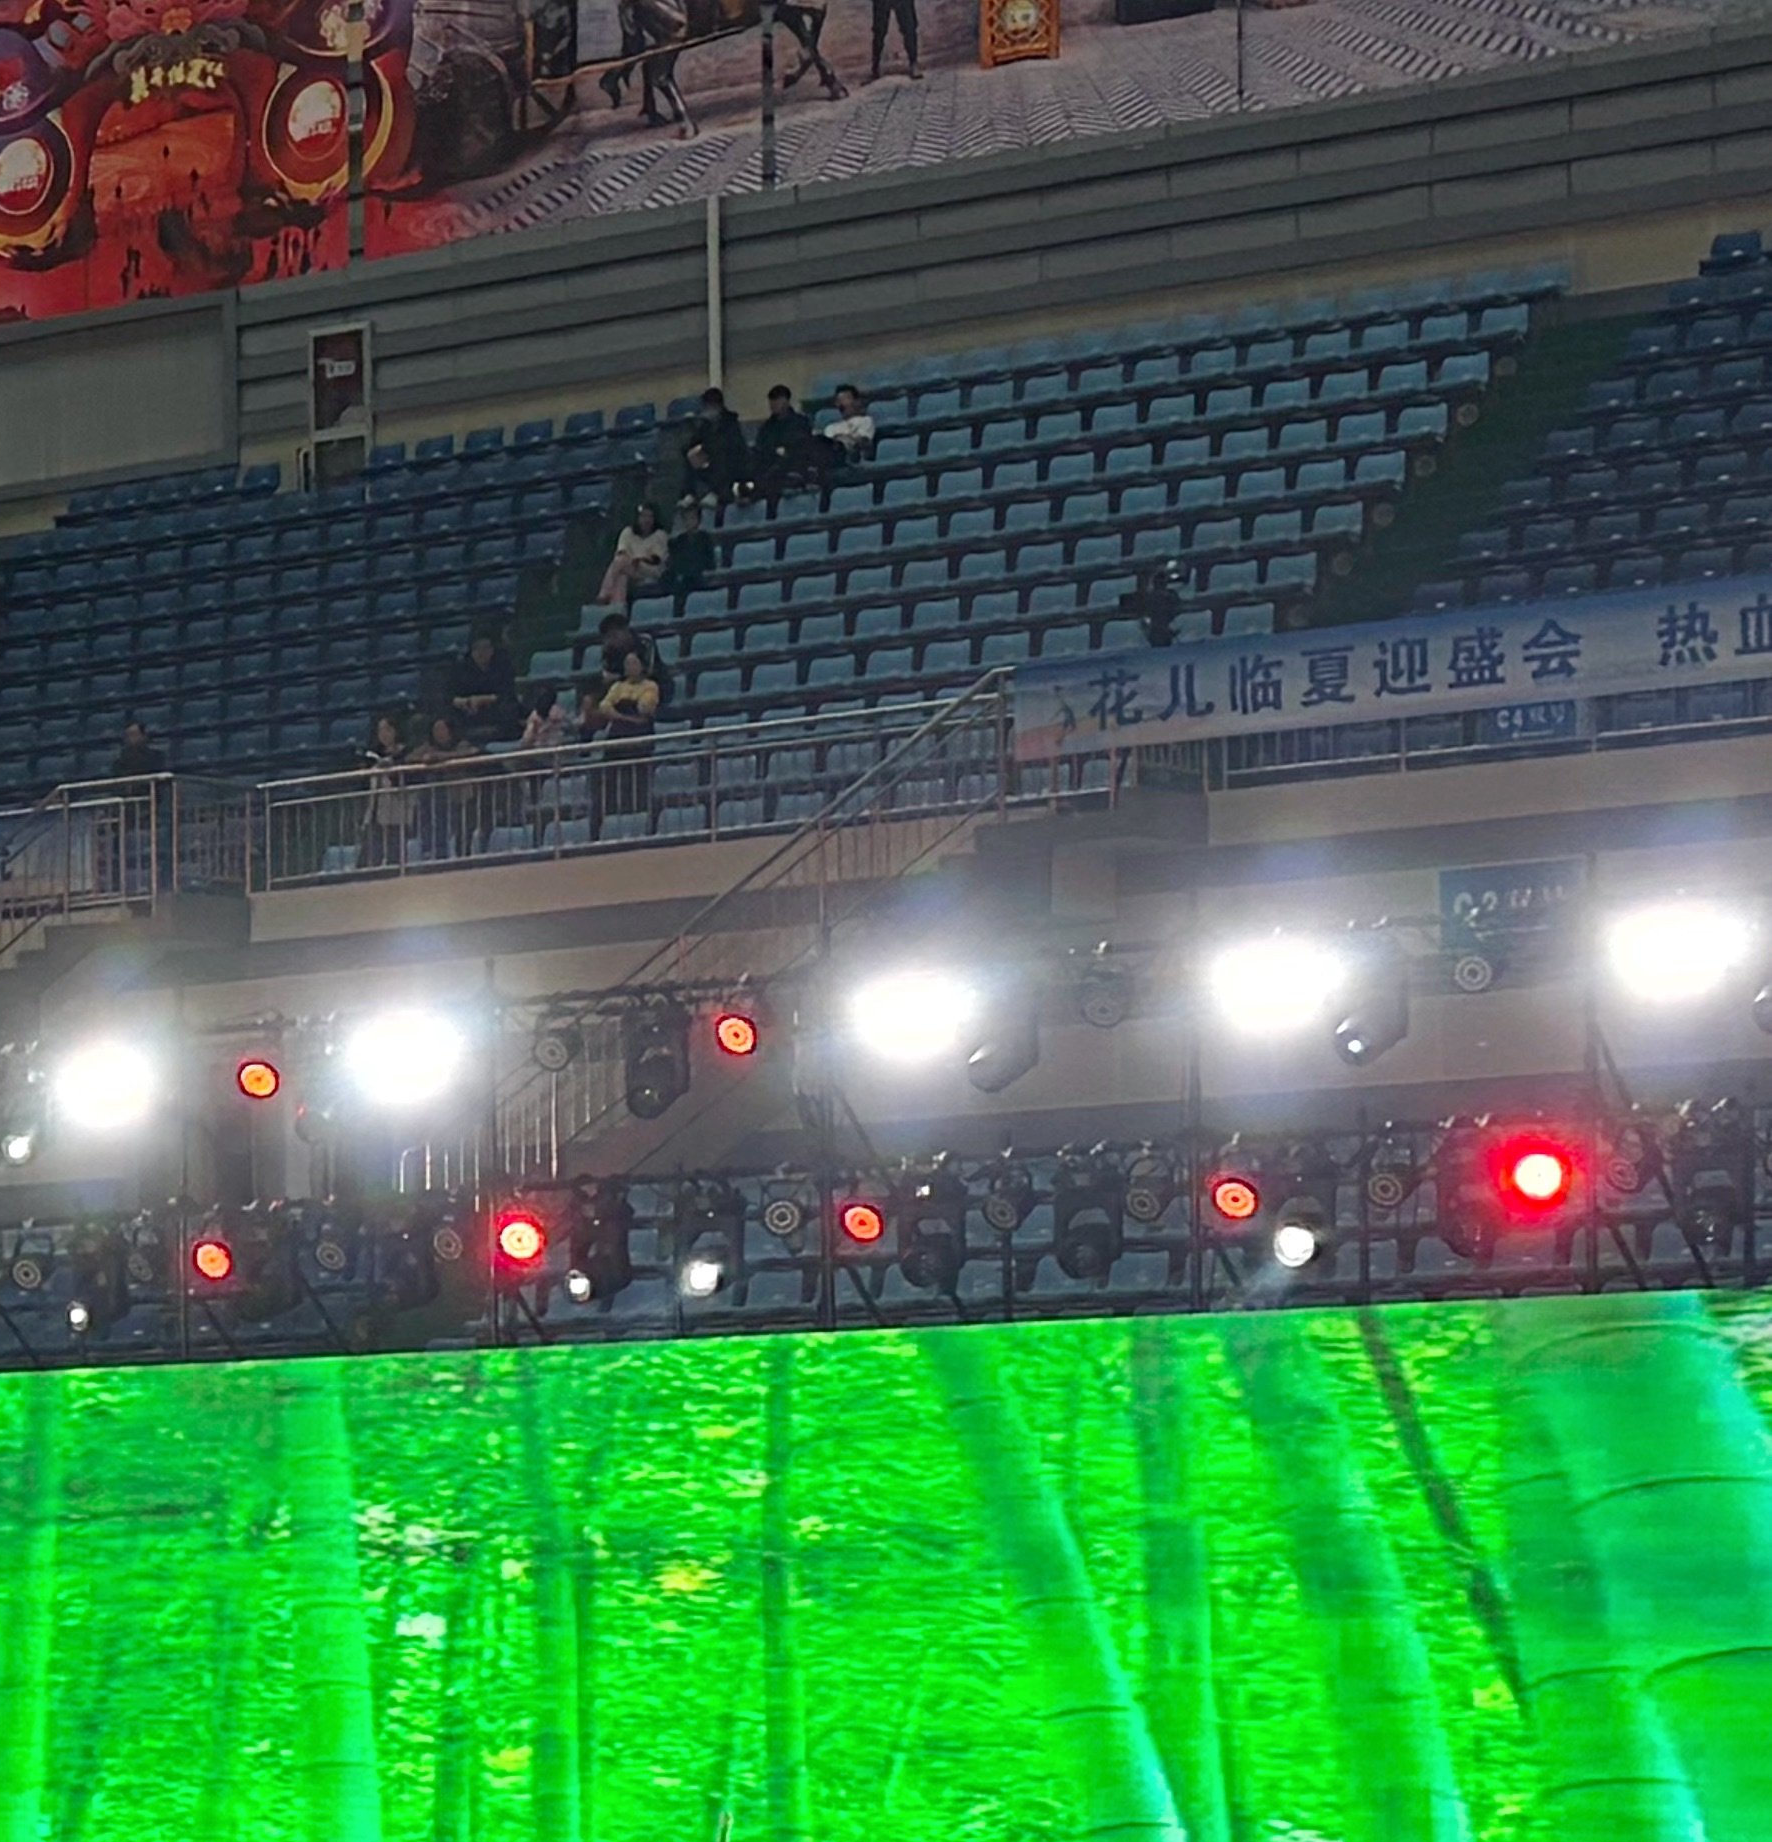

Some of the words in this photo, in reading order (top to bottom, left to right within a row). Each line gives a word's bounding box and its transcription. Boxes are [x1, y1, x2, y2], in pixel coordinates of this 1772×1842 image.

[1088, 617, 1584, 732] 花儿临夏迎盛会
[1656, 592, 1772, 667] 热血
